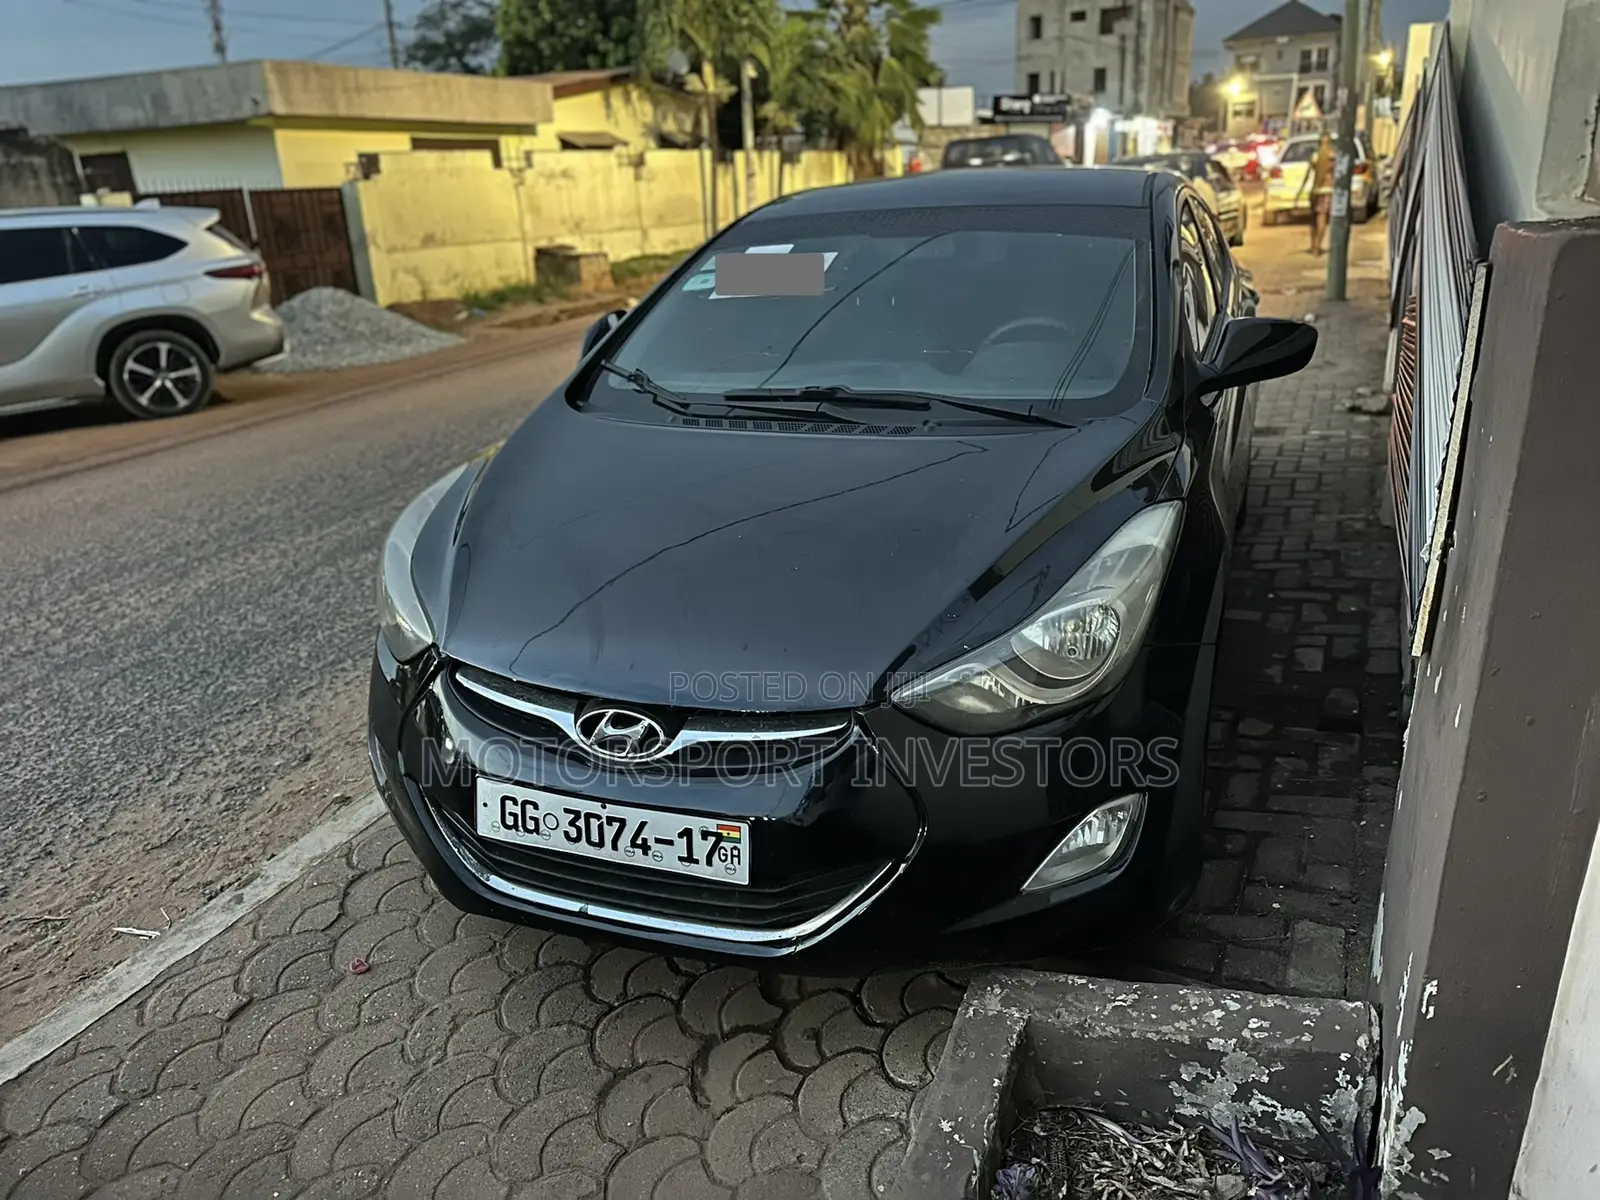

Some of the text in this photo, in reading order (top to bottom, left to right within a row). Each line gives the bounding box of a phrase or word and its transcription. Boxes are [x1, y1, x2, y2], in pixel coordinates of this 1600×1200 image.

[500, 795, 723, 867] GG 3074-17
[718, 845, 741, 866] GA
